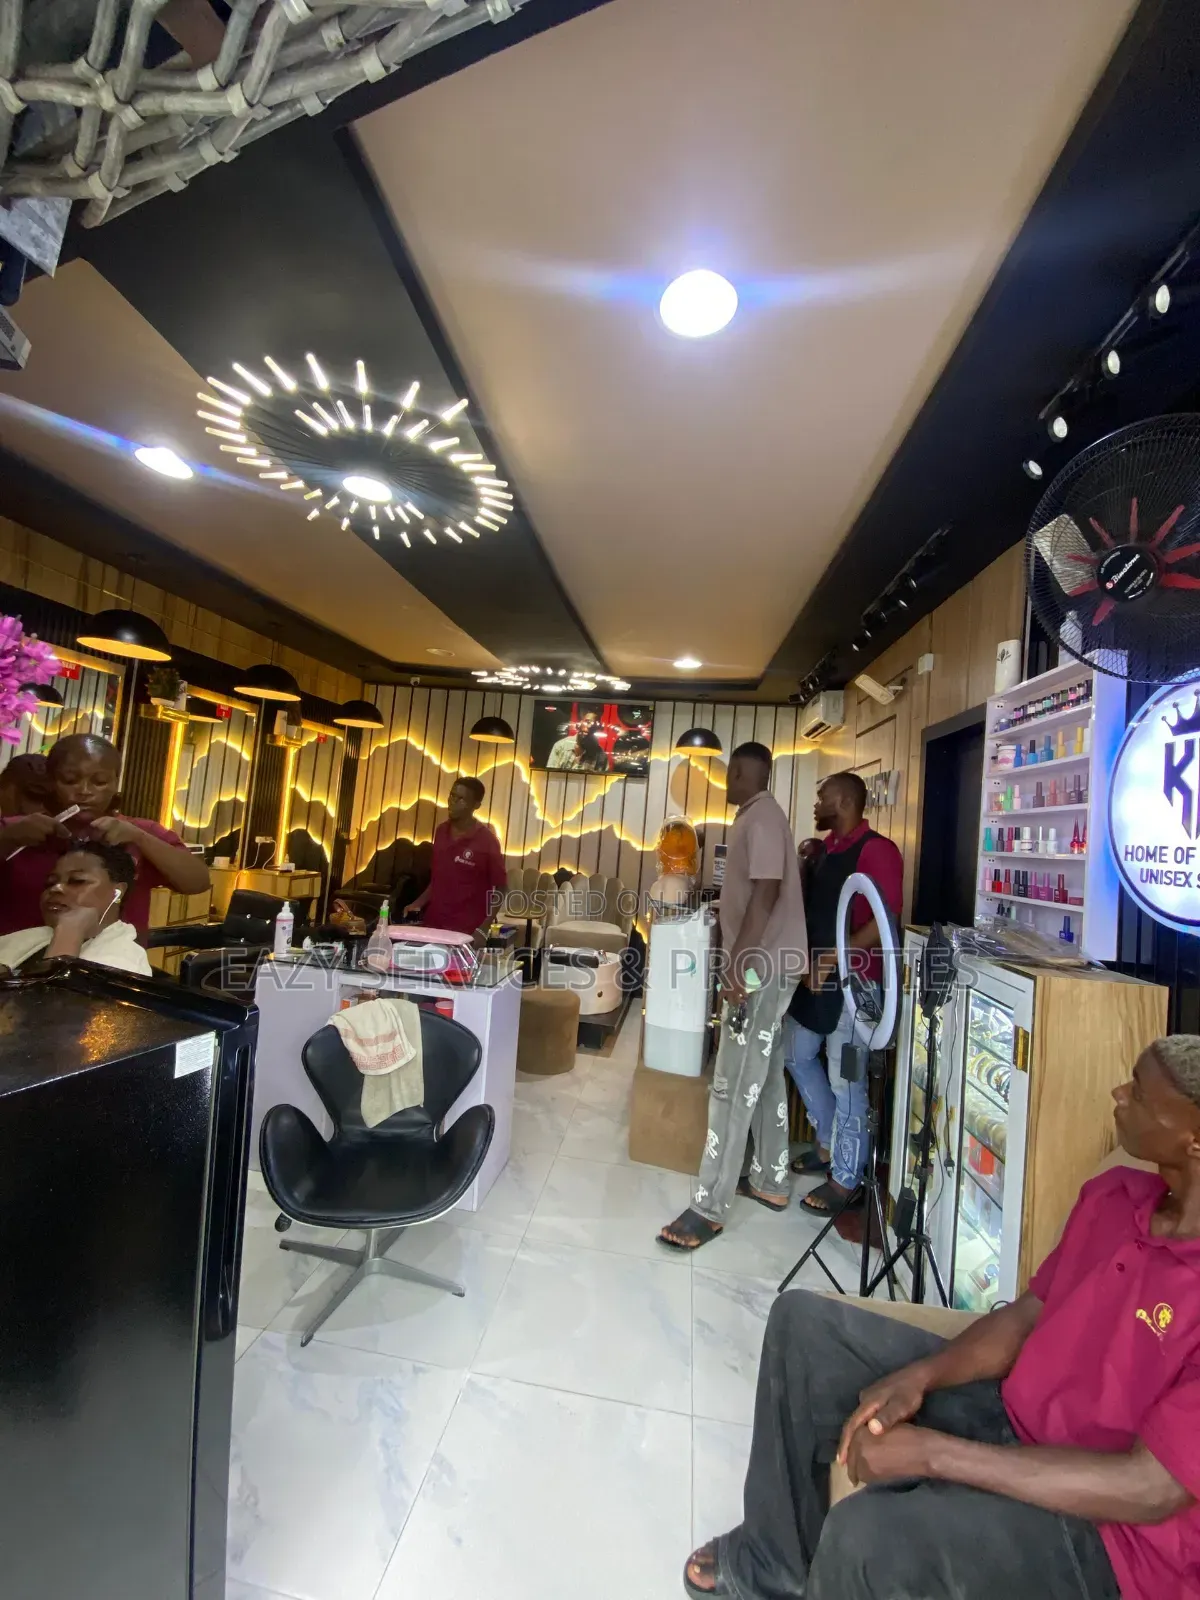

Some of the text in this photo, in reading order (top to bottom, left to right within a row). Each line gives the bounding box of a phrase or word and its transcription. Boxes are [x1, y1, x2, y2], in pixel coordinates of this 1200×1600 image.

[1124, 844, 1197, 865] HOME OF
[1139, 867, 1193, 889] UNISEX
